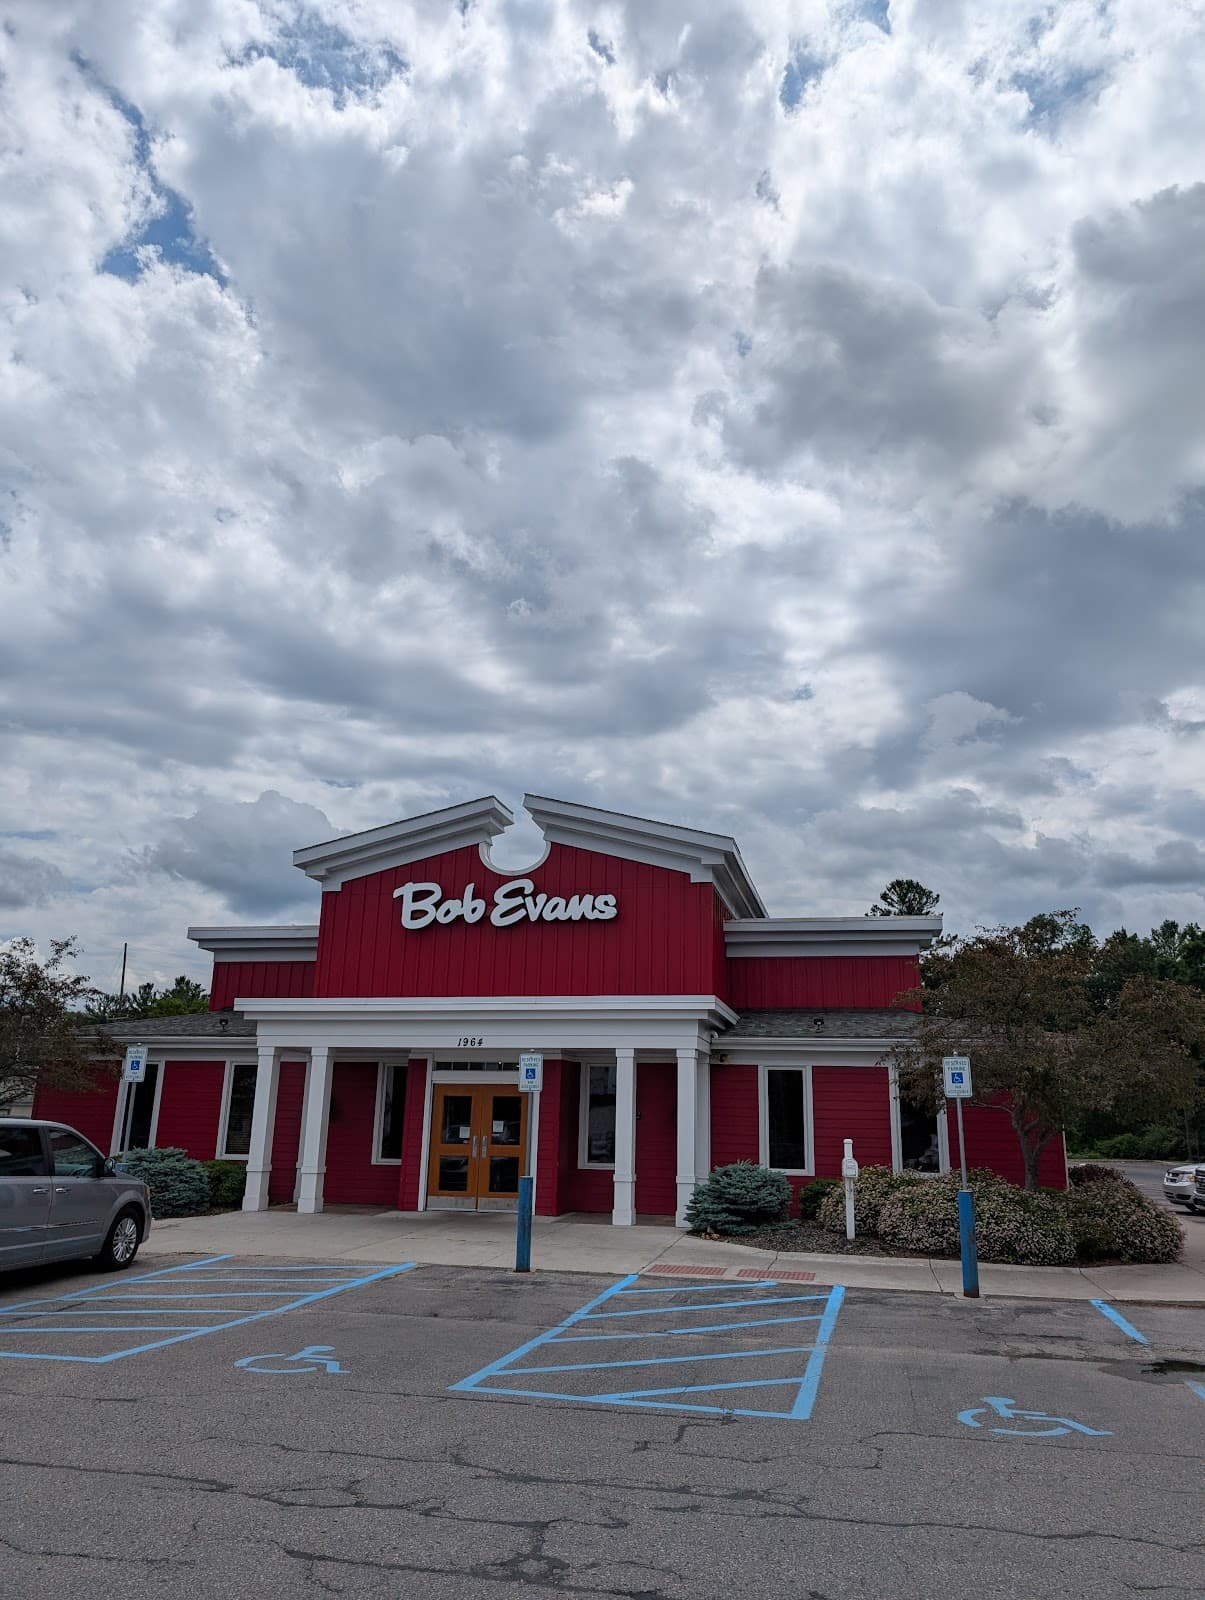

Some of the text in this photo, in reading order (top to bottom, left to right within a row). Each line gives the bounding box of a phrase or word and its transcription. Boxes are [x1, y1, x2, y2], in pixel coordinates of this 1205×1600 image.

[392, 878, 618, 930] Bob Evans
[457, 1037, 483, 1047] 1964
